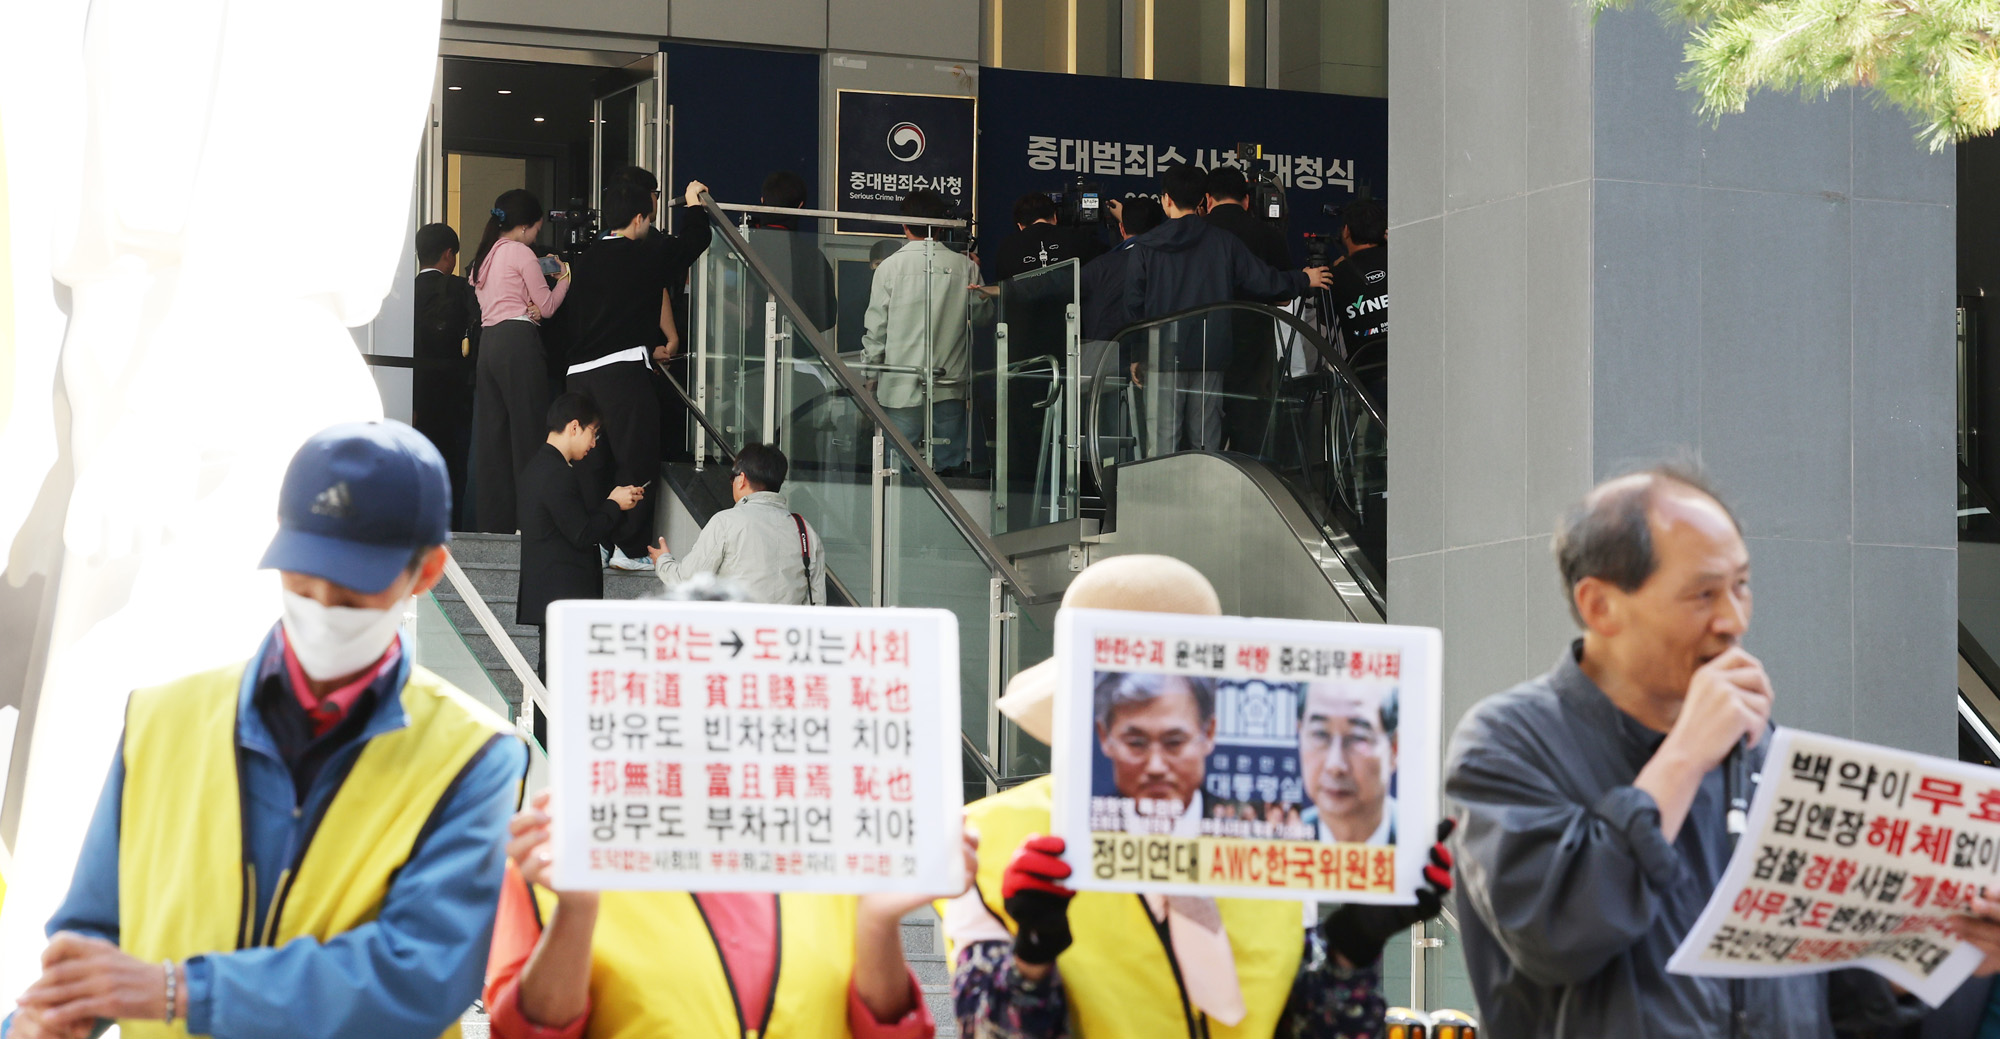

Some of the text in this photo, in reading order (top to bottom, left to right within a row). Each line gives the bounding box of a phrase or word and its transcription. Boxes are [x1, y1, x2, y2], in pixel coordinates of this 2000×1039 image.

[849, 171, 962, 195] 중대범죄수사청
[1262, 153, 1354, 193] 개청식
[849, 191, 874, 200] Serious
[874, 193, 894, 201] Crime
[588, 623, 713, 661] 도덕없는
[1175, 640, 1226, 670] 윤석열
[1236, 644, 1270, 674] 석방
[588, 670, 681, 708] 邦有道
[589, 713, 912, 756] 방유도 빈차천언 치야
[590, 761, 683, 798] 邦無道
[705, 763, 831, 799] 富且貴焉
[1206, 773, 1303, 803] 대통령실
[590, 803, 914, 844] 방무도 부차귀언 치야
[1093, 838, 1396, 893] 정의연대 AWC한국위원회
